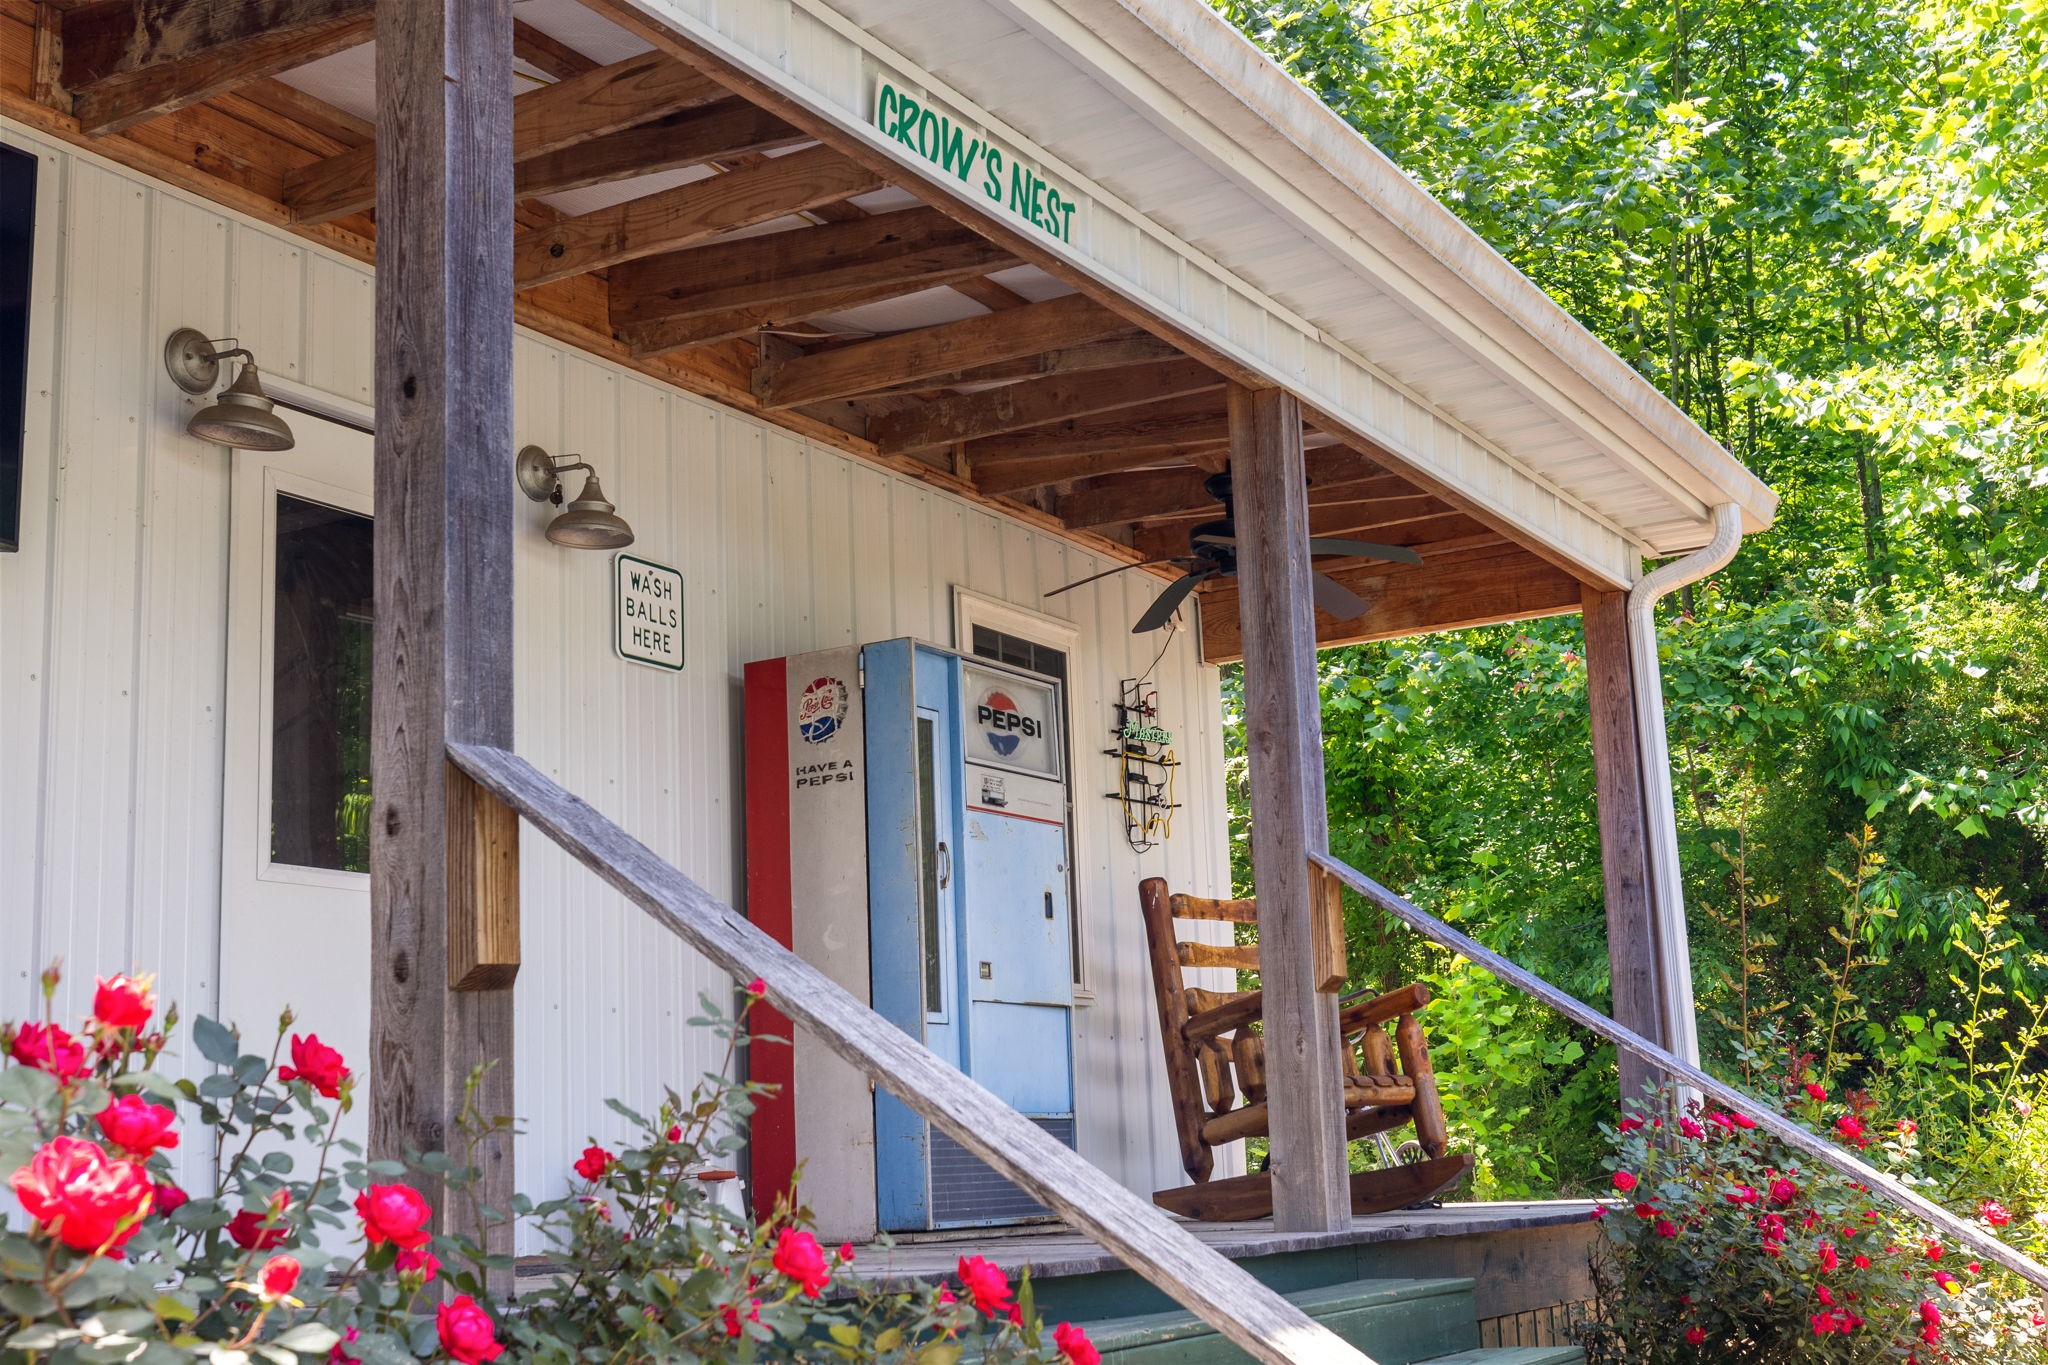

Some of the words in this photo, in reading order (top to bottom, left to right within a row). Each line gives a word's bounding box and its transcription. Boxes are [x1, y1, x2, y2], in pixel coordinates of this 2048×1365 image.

[879, 84, 1002, 203] CROW'S
[1010, 162, 1076, 244] NEST
[630, 571, 672, 601] WASH
[626, 597, 677, 628] BALLS
[633, 626, 671, 654] HERE
[978, 705, 1042, 739] PEPSI
[796, 761, 837, 776] HAVE
[843, 759, 853, 768] A
[796, 771, 854, 789] PEPSI
